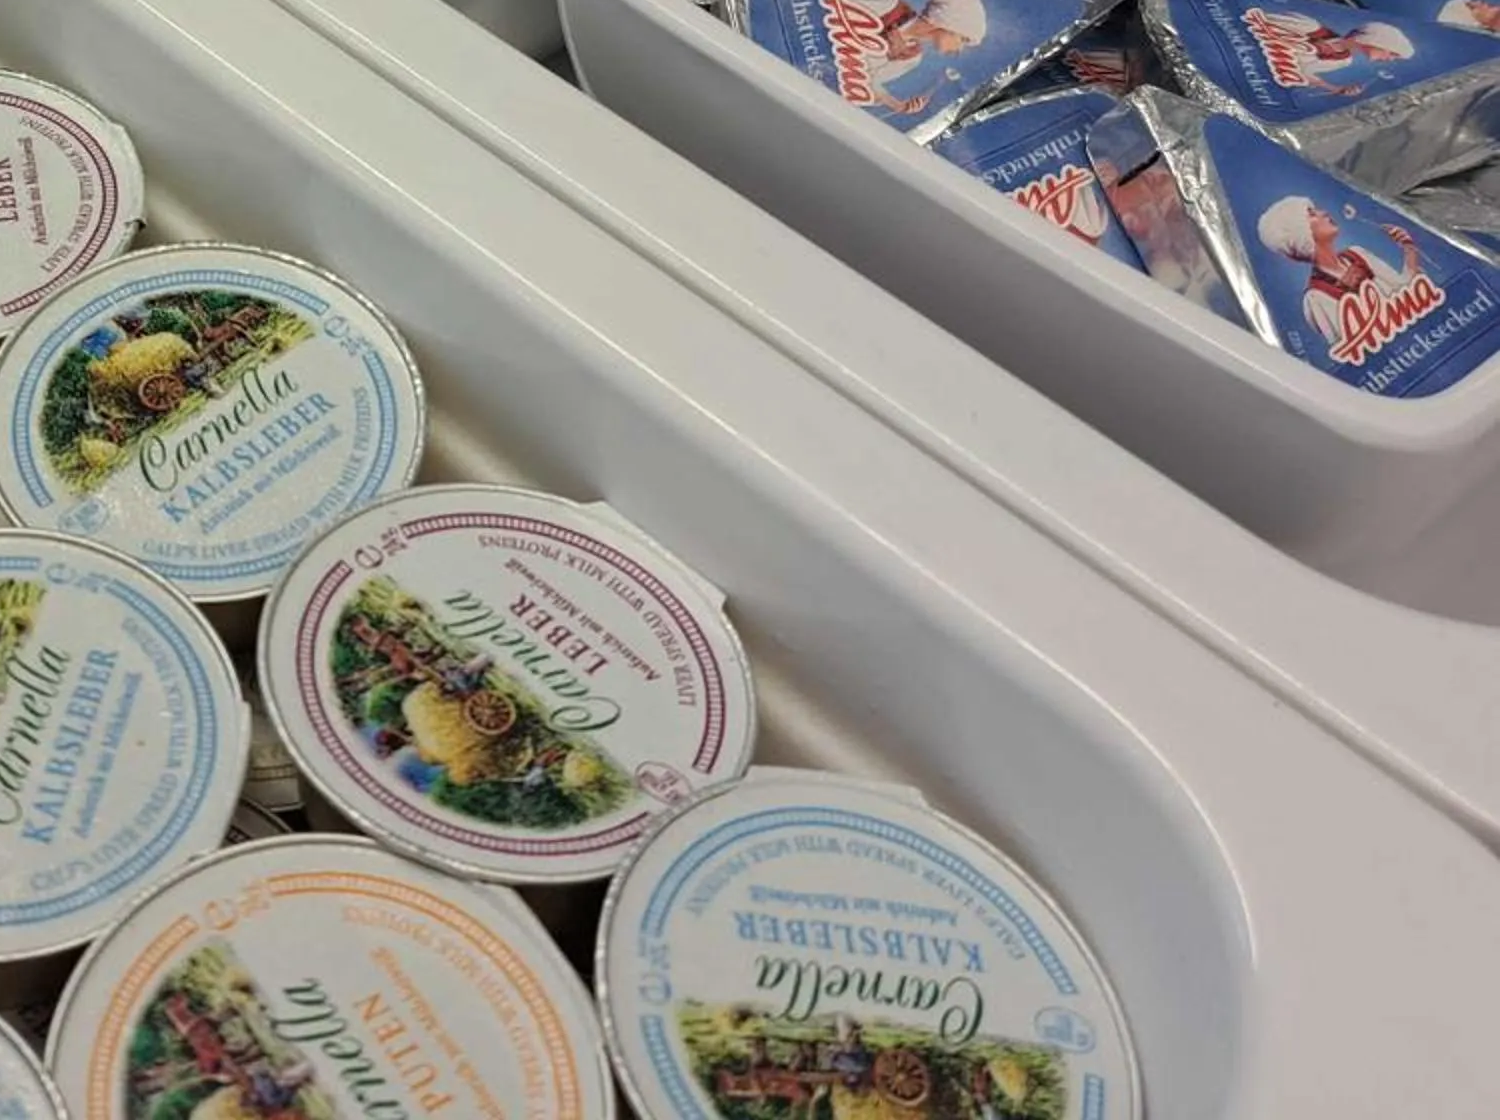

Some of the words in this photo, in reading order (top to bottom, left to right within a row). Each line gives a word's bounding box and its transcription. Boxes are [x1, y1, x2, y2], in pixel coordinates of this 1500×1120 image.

[1241, 9, 1308, 86] Alma
[1330, 275, 1444, 363] Alma
[1361, 288, 1495, 393] ühstückseckerl
[138, 366, 300, 489] Carnella
[157, 389, 338, 523] KALBSLEBER
[478, 534, 561, 563] PROTEINS
[562, 551, 609, 583] MILK
[505, 592, 609, 675] LEBER
[573, 613, 603, 637] mit
[603, 575, 651, 613] WITH
[638, 608, 687, 660] SPREAD
[440, 589, 618, 733] Carnella
[597, 632, 662, 684] Aufstrich
[670, 663, 698, 707] LIVER
[20, 645, 119, 843] KALBSLEBER
[732, 910, 983, 971] KALBSLEBER
[753, 957, 982, 1049] Carnella
[270, 977, 409, 1120] rnella
[351, 988, 456, 1114] PUTEN
